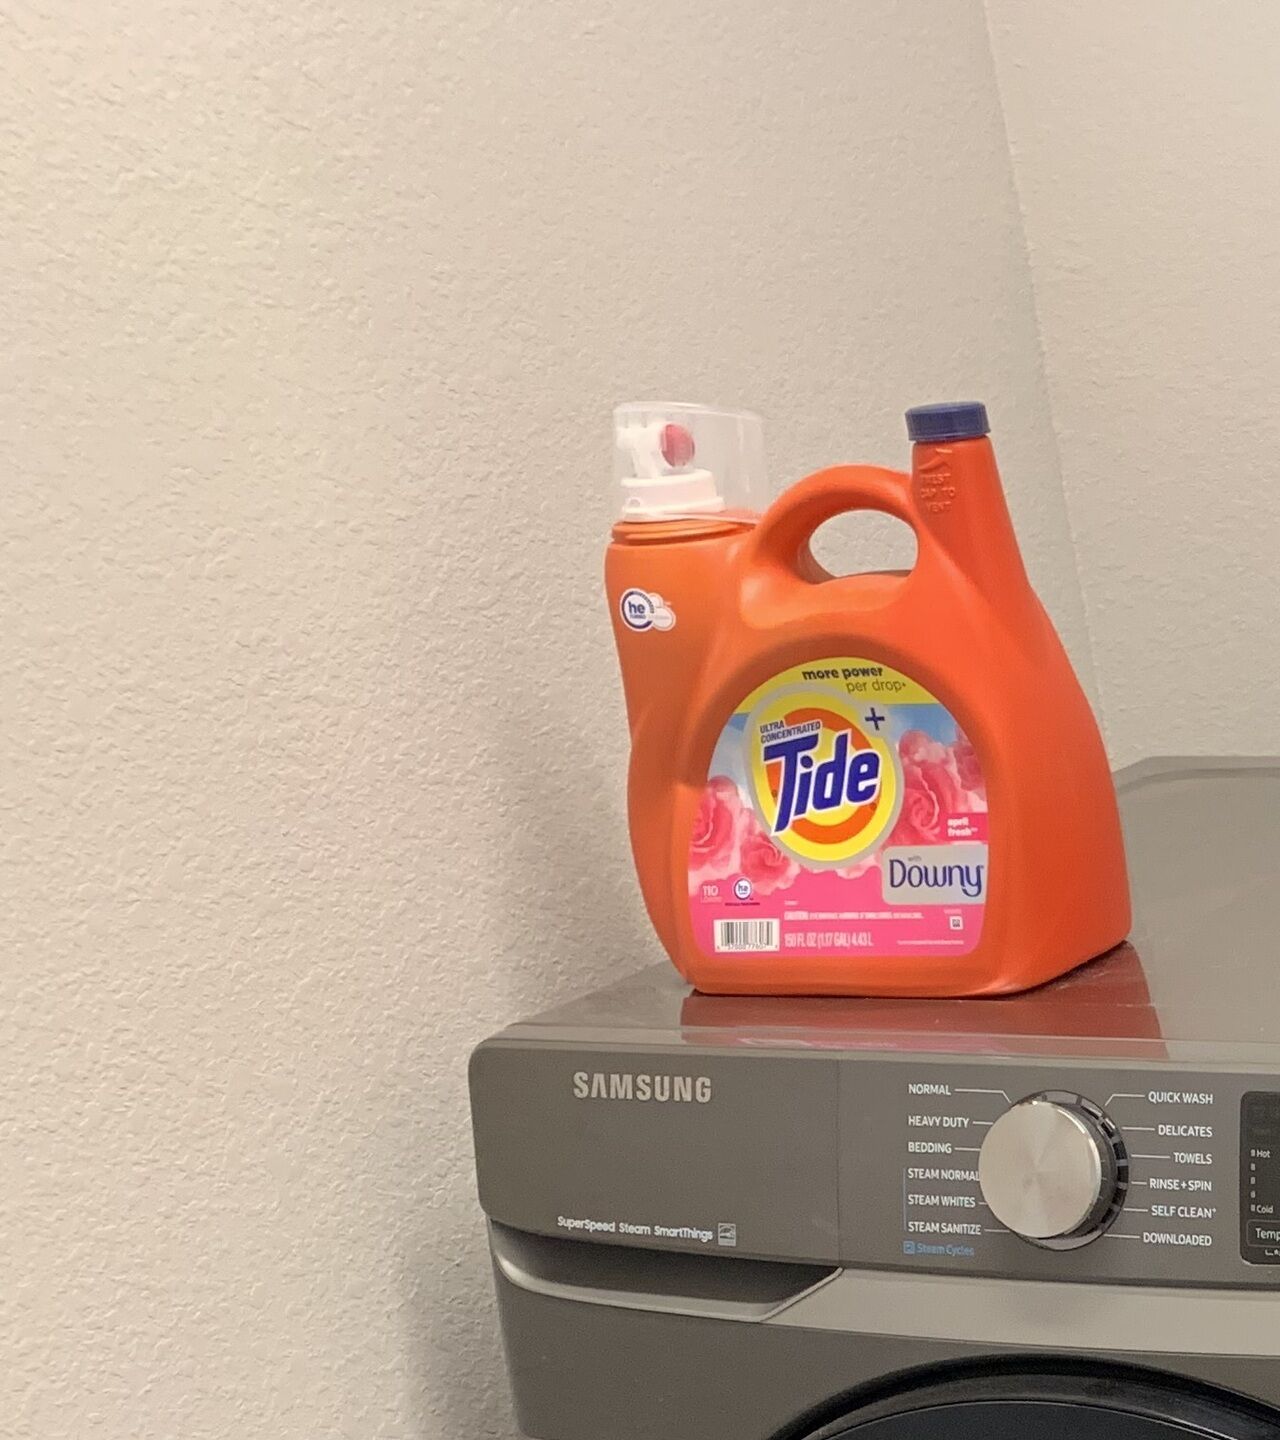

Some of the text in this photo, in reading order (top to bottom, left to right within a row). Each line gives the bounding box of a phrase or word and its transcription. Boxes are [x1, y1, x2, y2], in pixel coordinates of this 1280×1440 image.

[802, 667, 883, 681] more power
[846, 680, 867, 694] per
[760, 720, 785, 735] ULTRA
[761, 720, 821, 744] CONCENTRATED
[763, 732, 881, 833] Tide
[947, 817, 969, 828] april
[889, 859, 982, 897] Downy
[573, 1071, 712, 1103] SAMSUNG
[908, 1083, 951, 1096] NORMAL
[1148, 1091, 1213, 1104] QUICK WASH
[908, 1116, 969, 1128] HEAVY DUTY
[1158, 1124, 1213, 1137] DELICATES
[908, 1142, 952, 1154] BEDDING
[1256, 1150, 1271, 1158] Hot
[1173, 1152, 1213, 1164] TOWELS
[908, 1168, 980, 1181] STEAM NORMAL
[908, 1194, 976, 1208] STEAM WHITES
[1151, 1205, 1176, 1217] SELF
[1256, 1205, 1273, 1214] Cold
[557, 1216, 713, 1243] SuperSpeed Steam SmartThings
[908, 1221, 981, 1235] STEAM SANITIZE
[1143, 1232, 1213, 1246] DOWNLOADED
[917, 1242, 945, 1255] Steam
